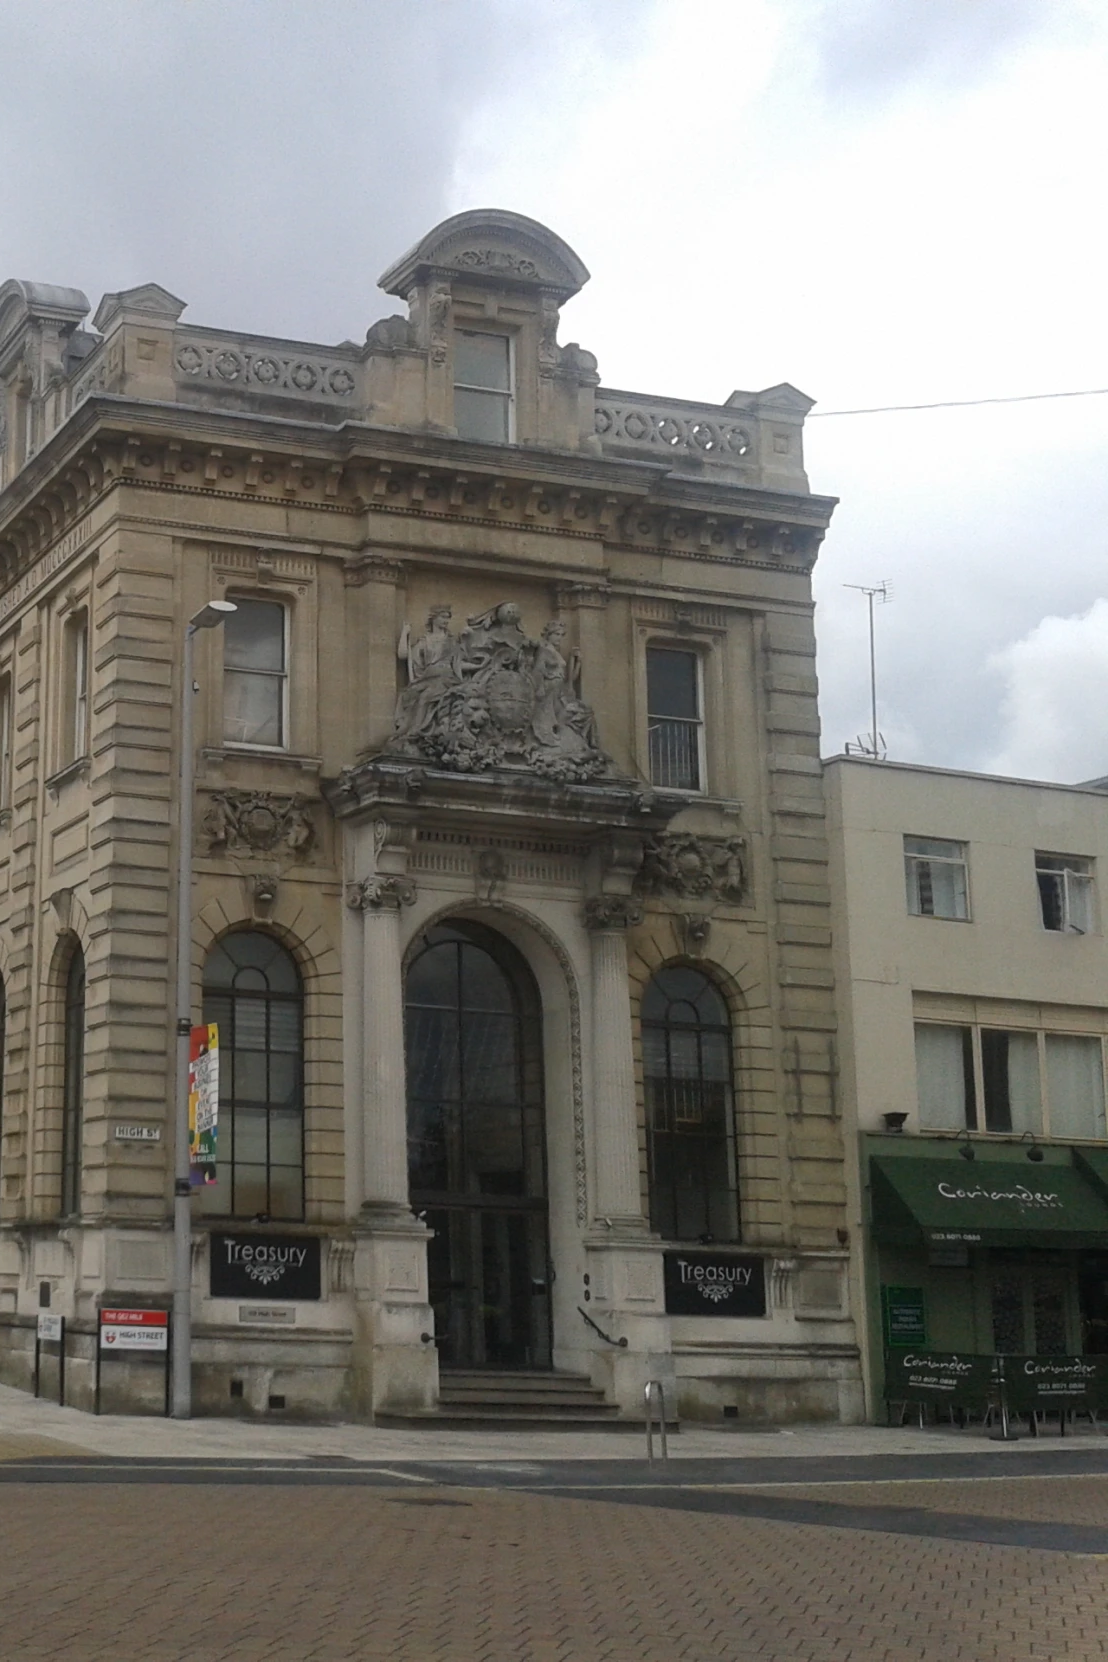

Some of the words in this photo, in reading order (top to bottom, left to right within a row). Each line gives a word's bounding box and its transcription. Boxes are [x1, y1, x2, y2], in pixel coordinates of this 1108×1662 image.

[118, 1126, 143, 1137] HIGH
[938, 1182, 1058, 1203] Coriander
[224, 1239, 307, 1268] Treasury
[677, 1260, 752, 1286] Treasury
[119, 1331, 136, 1339] HIGH
[137, 1331, 164, 1340] STREET
[904, 1355, 972, 1371] Coriander
[1024, 1358, 1096, 1375] Coriander
